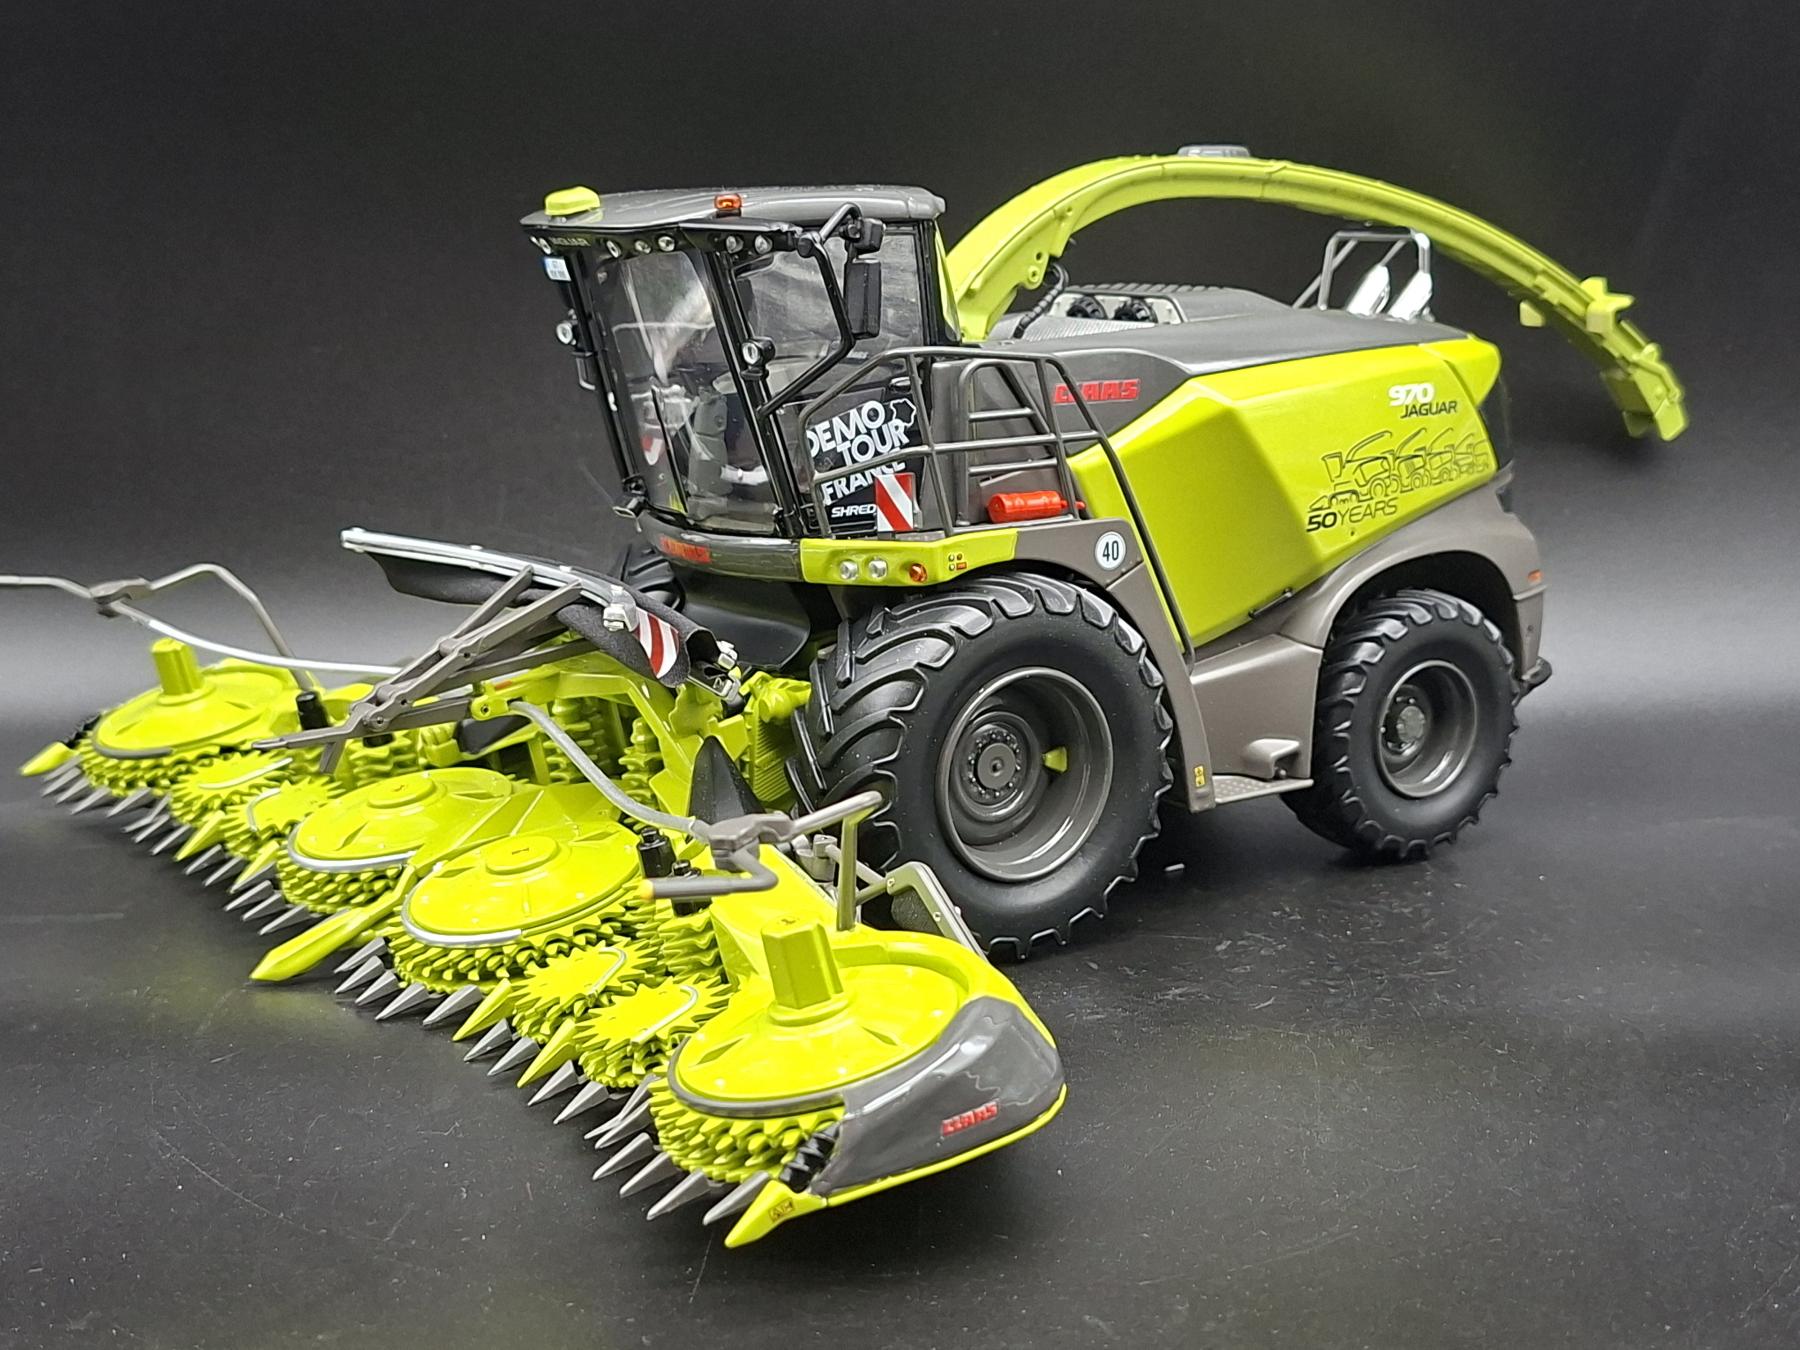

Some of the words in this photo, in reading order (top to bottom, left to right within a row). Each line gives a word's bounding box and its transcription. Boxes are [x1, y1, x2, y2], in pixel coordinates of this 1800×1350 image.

[1053, 379, 1140, 404] CAAS
[1388, 383, 1435, 406] 970
[1400, 400, 1457, 419] JAGUAR
[806, 401, 885, 458] DEMO
[837, 419, 910, 466] TOUR
[1306, 512, 1337, 532] 50
[1339, 497, 1399, 526] YEARS
[1102, 540, 1119, 562] 40
